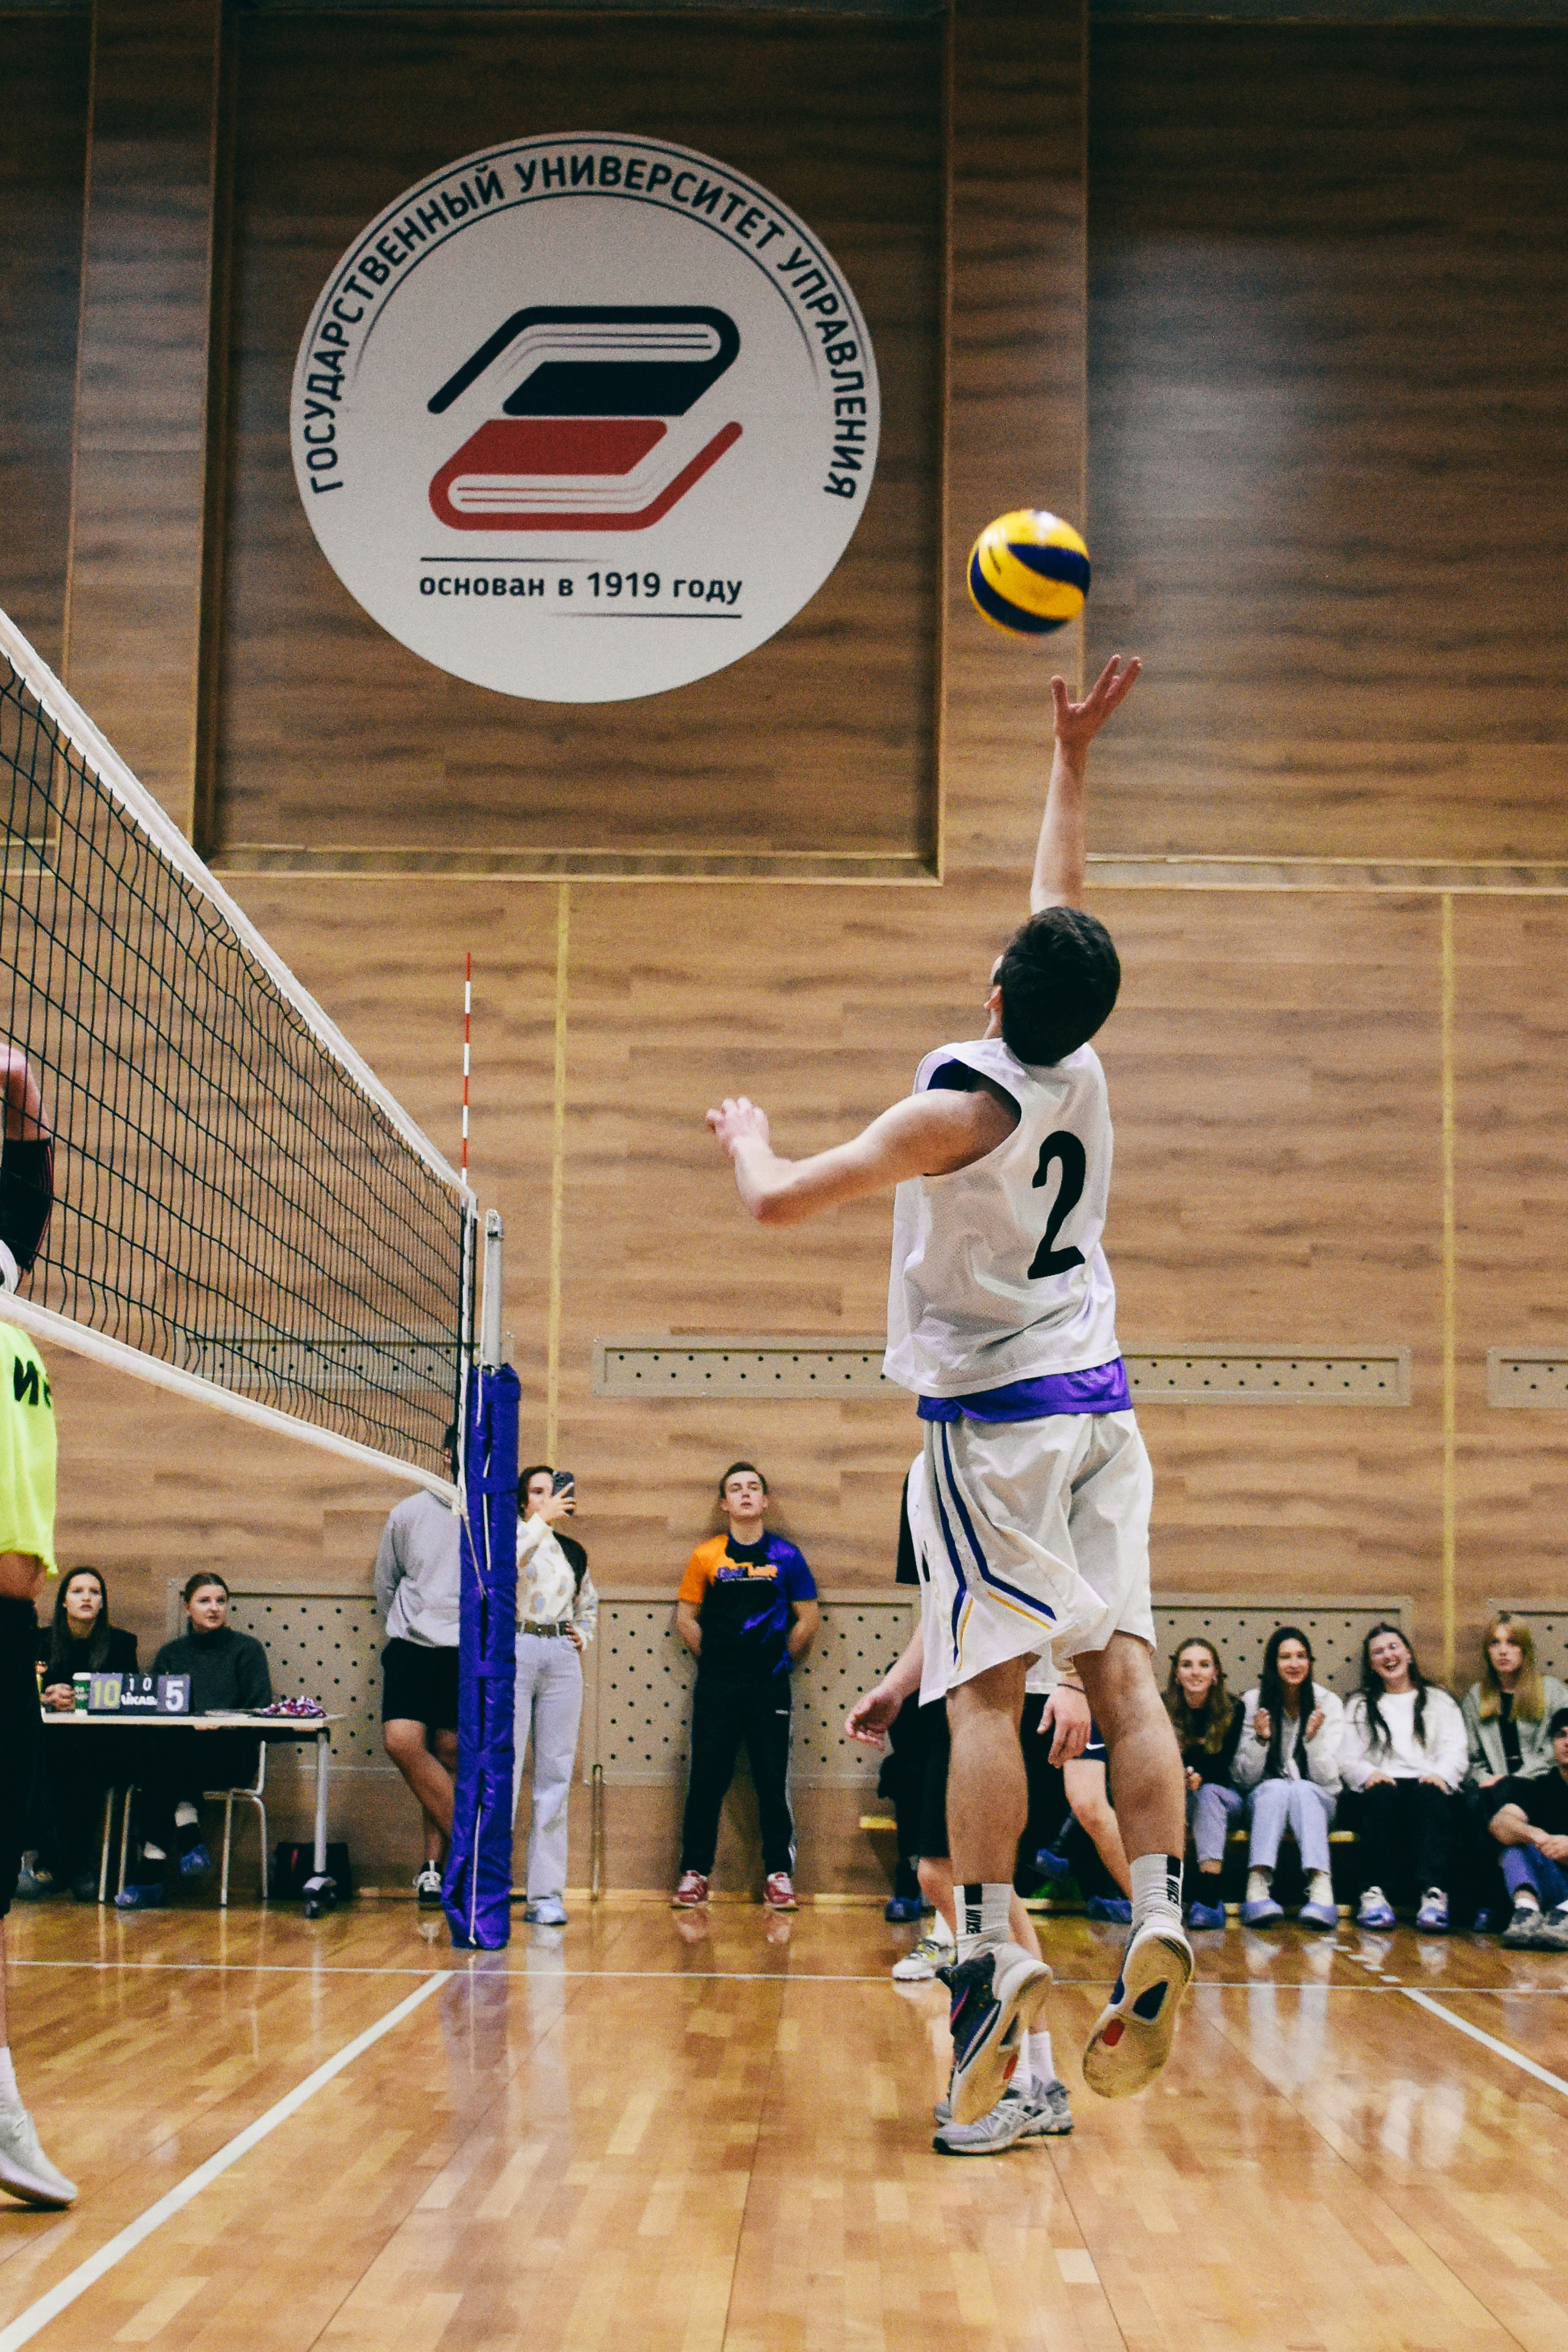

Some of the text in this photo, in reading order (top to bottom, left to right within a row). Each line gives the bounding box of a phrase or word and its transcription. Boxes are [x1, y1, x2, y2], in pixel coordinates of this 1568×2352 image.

[303, 153, 867, 499] ГОСУДАРСТВЕННЫЙ УНИВЕРСИТЕТ УПРАВЛЕНИЯ
[420, 571, 742, 605] основан в 1919 году
[1027, 1130, 1086, 1280] 2
[94, 1679, 120, 1707] 10
[165, 1680, 184, 1711] 5
